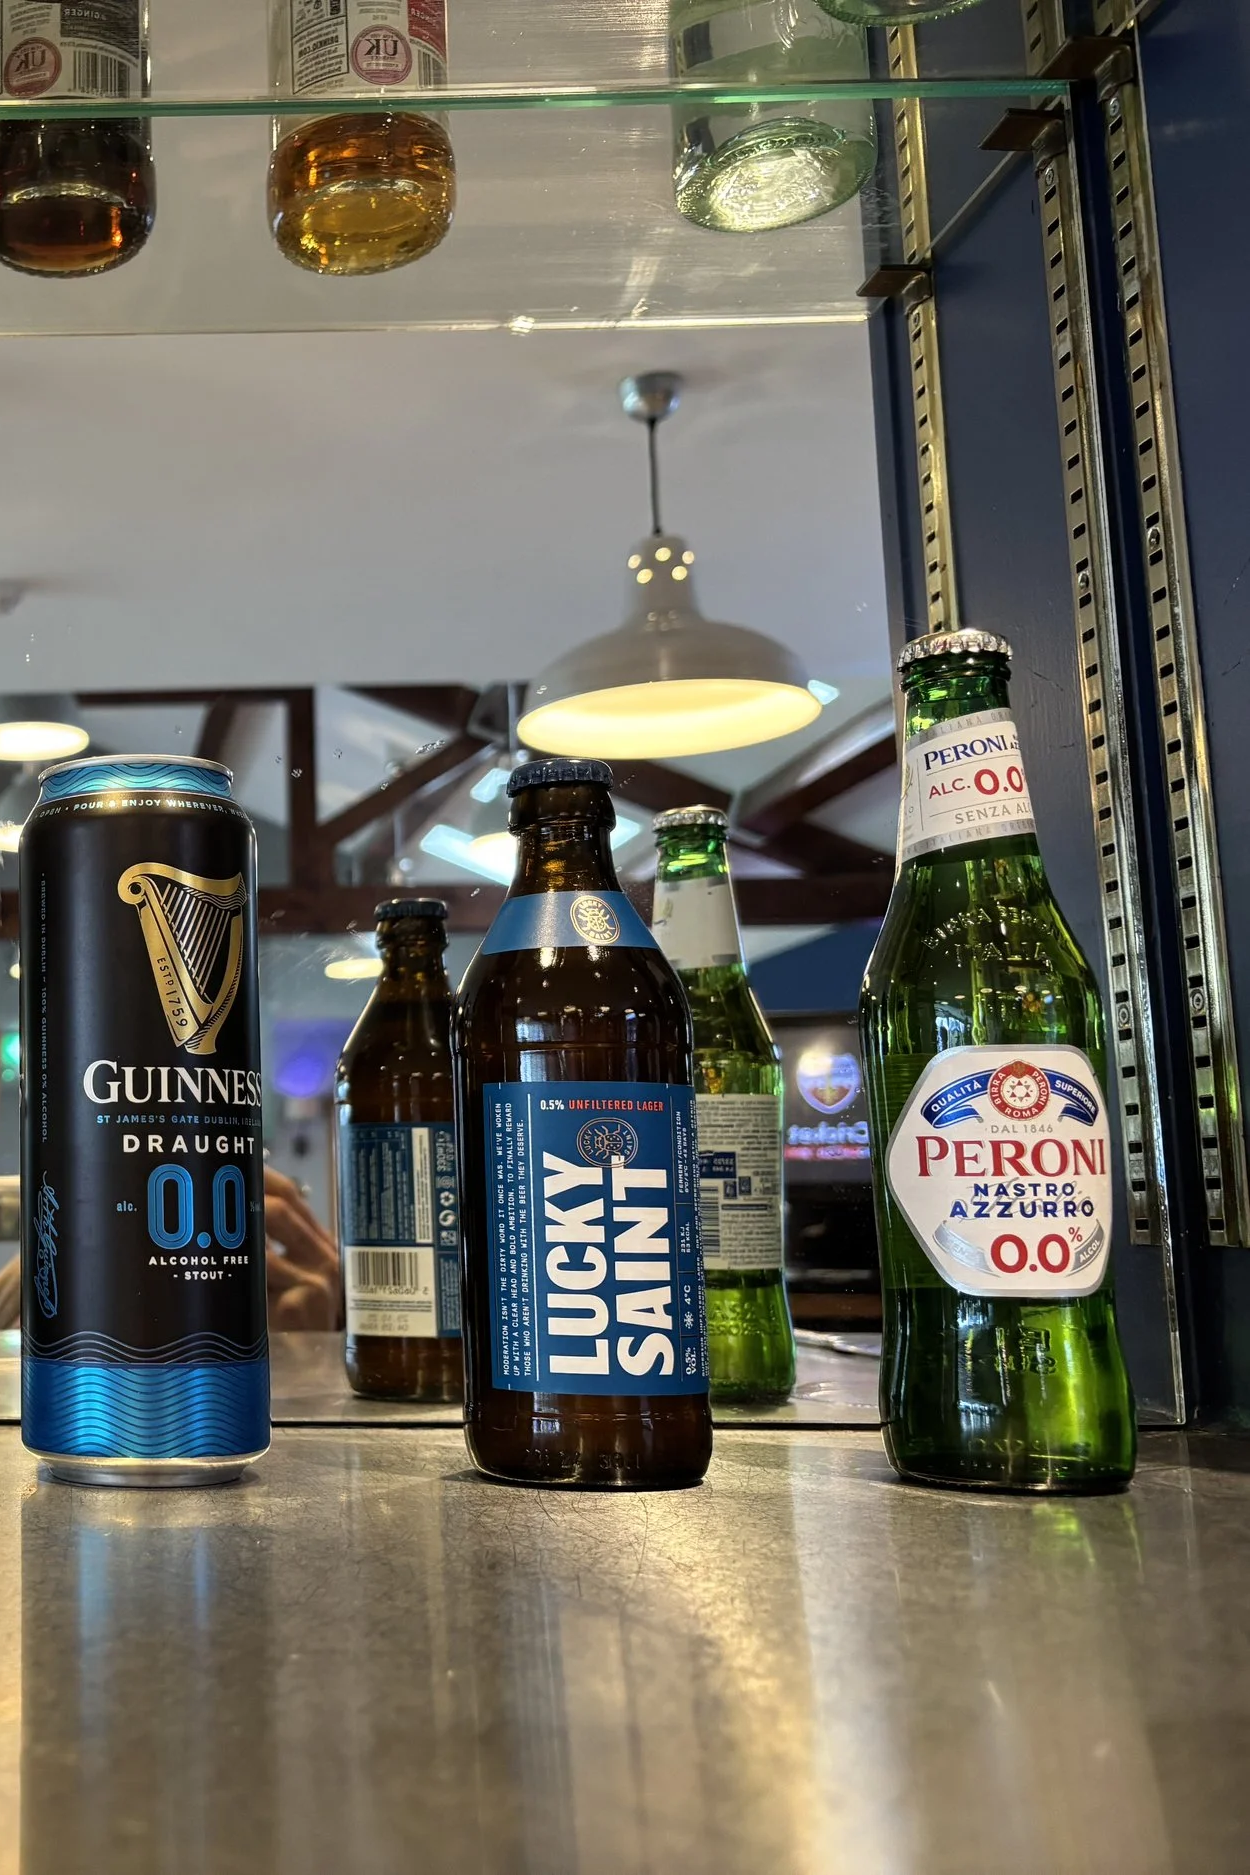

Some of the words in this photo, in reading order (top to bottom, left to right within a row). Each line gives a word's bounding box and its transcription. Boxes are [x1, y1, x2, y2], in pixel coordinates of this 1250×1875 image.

[924, 734, 1008, 771] PERONI
[929, 778, 970, 799] ALC.
[974, 765, 1026, 795] 0.0
[73, 801, 103, 811] POUR
[121, 799, 160, 808] ENJOY
[955, 804, 1011, 824] SENZA
[166, 990, 188, 1027] 1759
[41, 1073, 48, 1089] 0%
[83, 1059, 262, 1107] GUINNESS
[991, 1072, 1006, 1105] BIRRA
[1032, 1070, 1048, 1106] PERONI
[540, 1100, 564, 1110] 0.5%
[568, 1100, 633, 1111] UNFILTERED
[637, 1101, 664, 1112] LAGER
[931, 1079, 982, 1113] QUALITÀ
[1055, 1079, 1096, 1113] SUPERIORE
[97, 1115, 110, 1124] ST
[116, 1115, 166, 1124] JAMES'S
[171, 1115, 199, 1124] GATE
[204, 1116, 240, 1126] DUBLIN,
[1005, 1107, 1039, 1118] ROMA
[516, 1119, 524, 1157] DESERVE.
[991, 1124, 1019, 1134] DAL
[1024, 1123, 1053, 1134] 1846
[123, 1134, 255, 1154] DRAUGHT
[495, 1132, 503, 1156] WE'VE
[583, 1129, 594, 1156] LUCKY
[623, 1130, 631, 1156] SAINT
[675, 1111, 684, 1193] FERMENT/CONDITION
[915, 1135, 1108, 1177] PERONI
[507, 1173, 514, 1183] TO
[517, 1161, 525, 1181] THEY
[518, 1185, 526, 1205] BEER
[973, 1183, 1075, 1197] NASTRO
[116, 1201, 137, 1212] alc.
[147, 1163, 246, 1250] 0.0
[498, 1209, 505, 1219] IT
[507, 1188, 515, 1231] AMBITION.
[949, 1200, 1095, 1219] AZZURRO
[508, 1235, 516, 1255] BOLD
[1078, 1238, 1101, 1264] ALCOL
[149, 1256, 217, 1265] ALCOHOL
[223, 1255, 249, 1265] FREE
[499, 1248, 507, 1272] DIRTY
[509, 1258, 517, 1274] AND
[542, 1151, 610, 1375] LUCKY
[611, 1155, 675, 1376] SAINT
[520, 1253, 529, 1293] DRINKING
[510, 1278, 518, 1299] HEAD
[511, 1302, 519, 1328] CLEAR
[522, 1297, 530, 1327] AREN'T
[502, 1325, 510, 1375] MODERATION
[523, 1331, 531, 1347] WHO
[513, 1365, 520, 1376] UP
